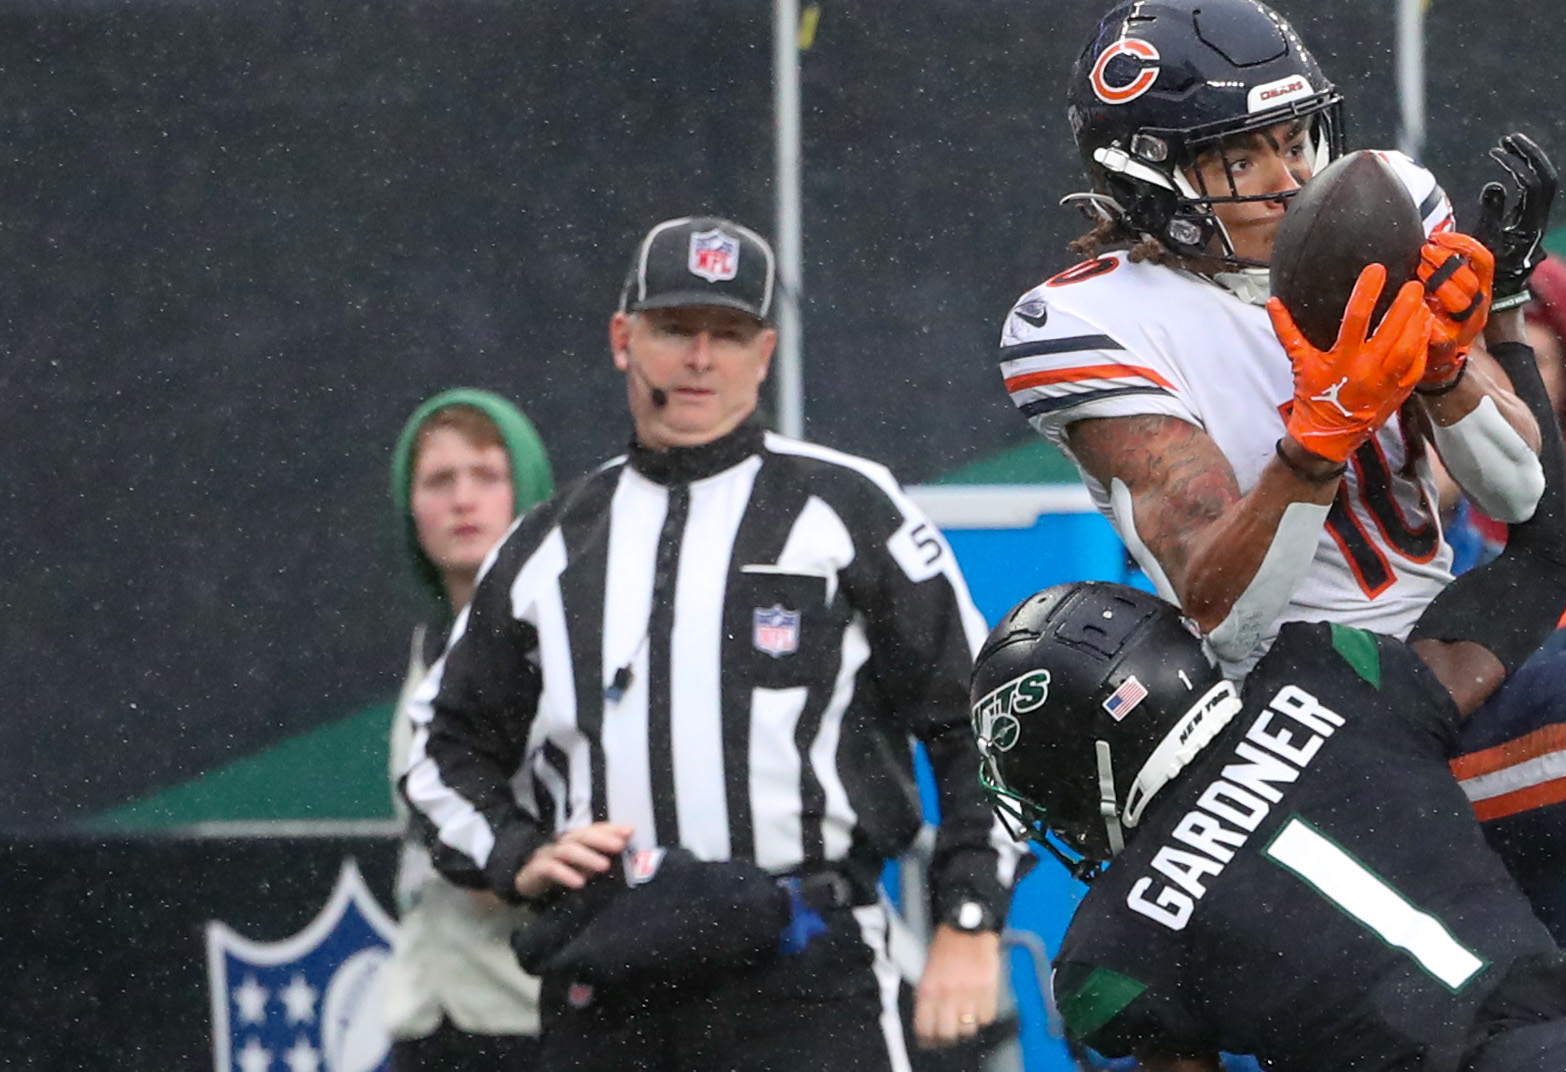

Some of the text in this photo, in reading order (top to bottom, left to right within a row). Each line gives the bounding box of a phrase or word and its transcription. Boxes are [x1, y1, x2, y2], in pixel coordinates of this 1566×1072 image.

[1089, 38, 1160, 105] C
[696, 249, 732, 275] NFL
[911, 523, 943, 566] 5
[1178, 669, 1193, 691] 1
[1178, 708, 1203, 746] NEW
[1126, 684, 1346, 931] GARDNER
[1261, 813, 1491, 995] 1
